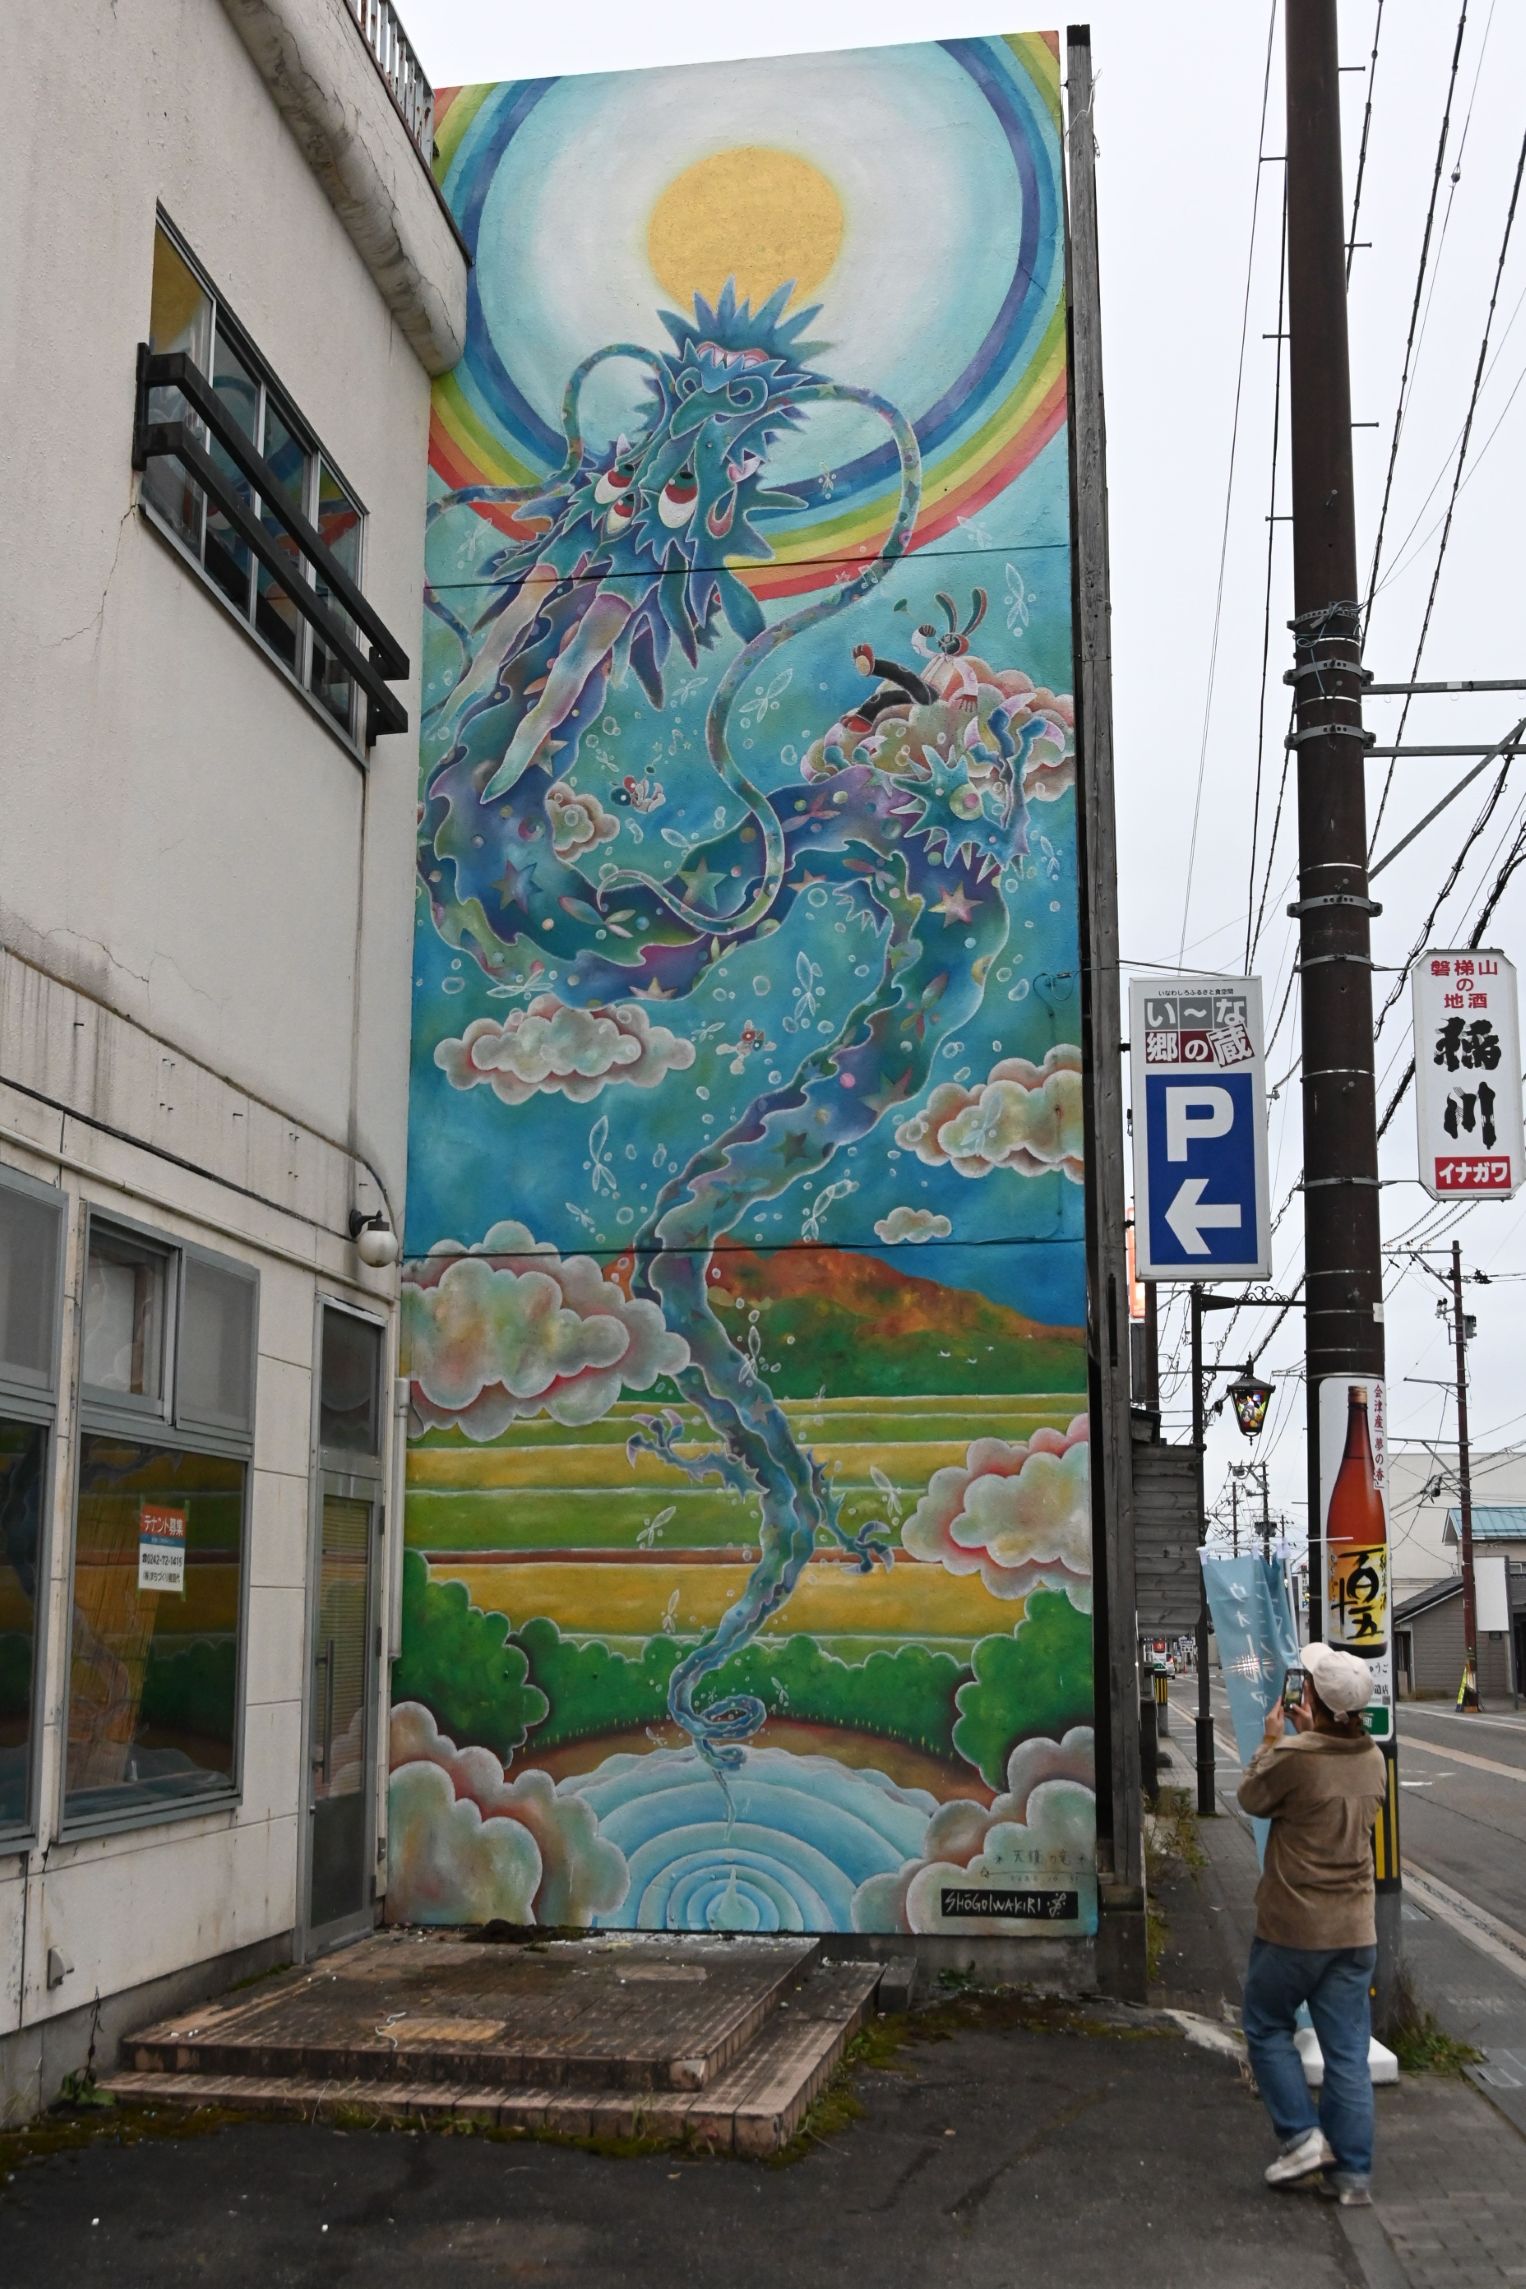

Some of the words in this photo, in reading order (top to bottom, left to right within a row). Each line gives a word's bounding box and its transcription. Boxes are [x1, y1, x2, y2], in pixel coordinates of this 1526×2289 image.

[1431, 960, 1498, 976] 磐梯山
[1456, 978, 1474, 992] の
[1444, 993, 1488, 1009] 地酒
[1146, 1026, 1251, 1066] 郷の蔵
[1166, 1086, 1234, 1162] P
[1439, 1161, 1508, 1185] イナガワ
[143, 1515, 184, 1537] テナント募集
